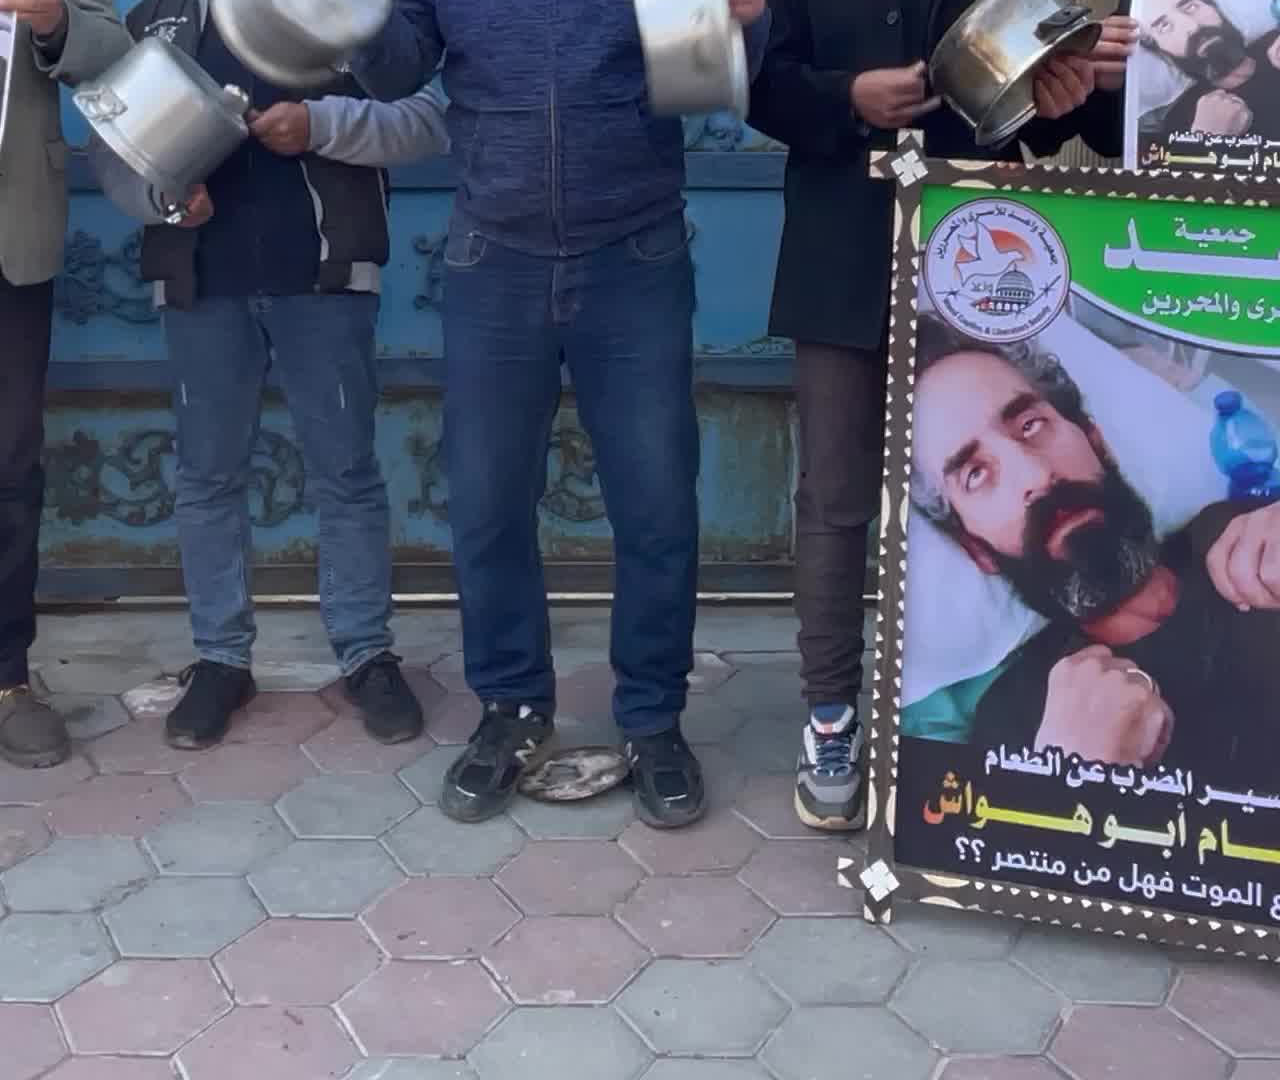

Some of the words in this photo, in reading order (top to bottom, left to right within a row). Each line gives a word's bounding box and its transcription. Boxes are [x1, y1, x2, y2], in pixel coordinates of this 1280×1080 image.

[1174, 217, 1256, 250] جمعية
[1142, 289, 1240, 320] والمحررين
[985, 745, 1060, 777] الطعام
[1066, 754, 1105, 788] عن
[1112, 766, 1193, 797] المضرب
[922, 771, 1092, 836] هواش
[1098, 802, 1186, 859] أبو
[954, 837, 985, 862] ؟؟
[991, 850, 1066, 876] منتصر
[1074, 861, 1111, 885] من
[1119, 865, 1174, 900] فهل
[1182, 873, 1261, 908] الموت
